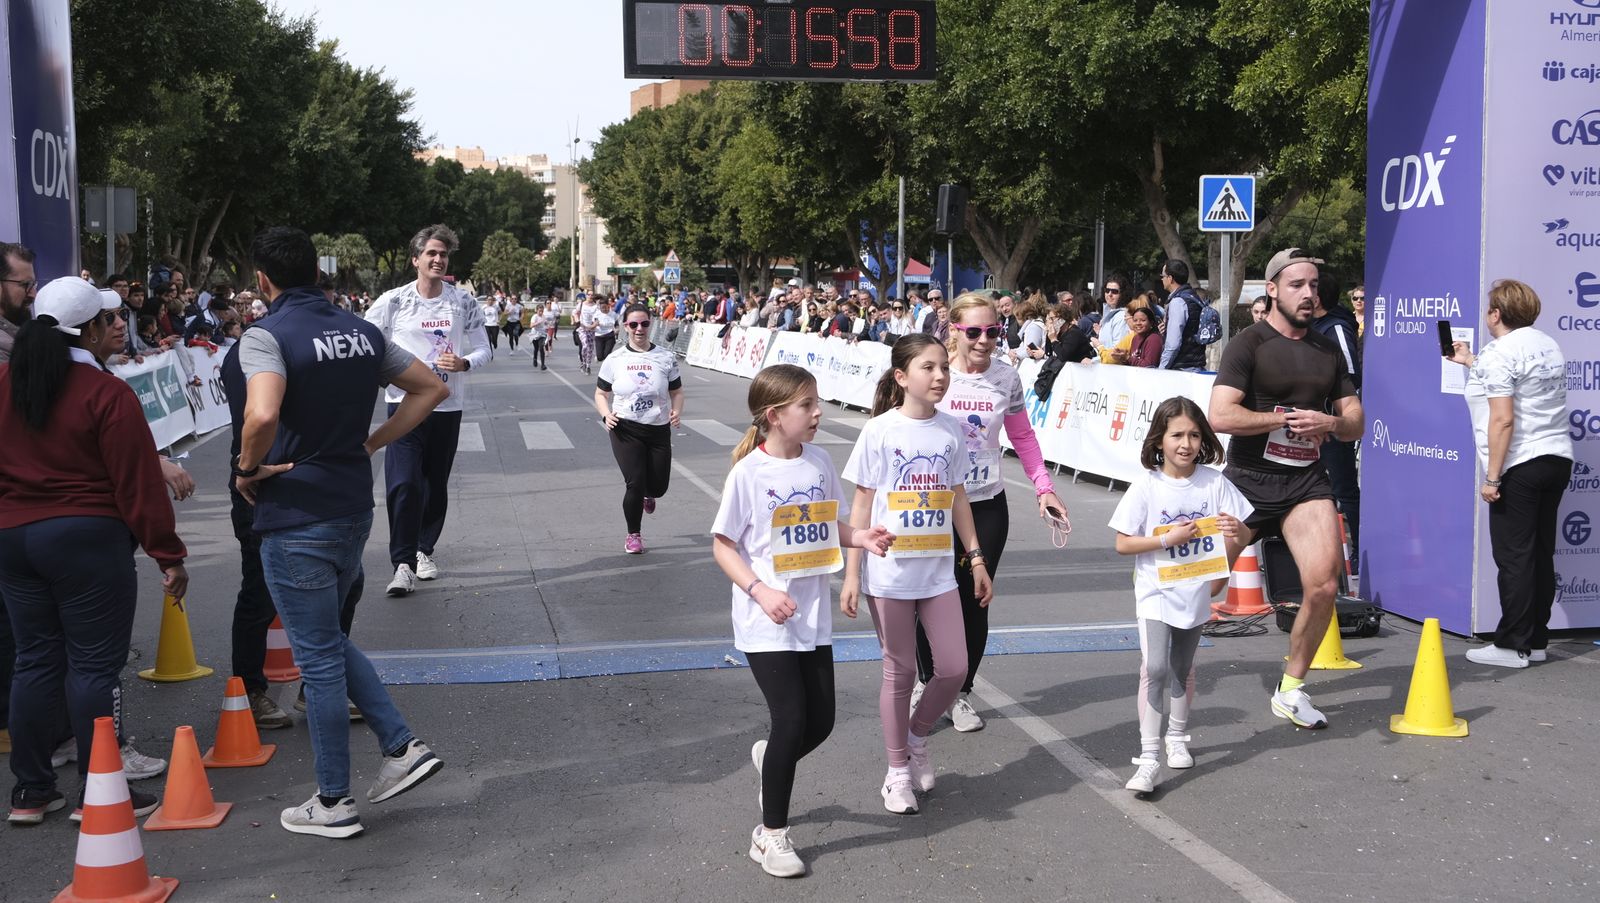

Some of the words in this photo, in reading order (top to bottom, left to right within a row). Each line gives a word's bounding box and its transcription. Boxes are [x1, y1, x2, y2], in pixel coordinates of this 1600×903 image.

[1381, 136, 1457, 212] CDX
[1395, 293, 1462, 318] ALMERÍA
[421, 320, 451, 329] MUJER
[1394, 321, 1426, 334] CIUDAD
[312, 329, 376, 362] NEXA
[950, 400, 994, 412] MUJER
[911, 474, 939, 485] MINI
[965, 466, 989, 480] 11
[899, 509, 945, 528] 1879
[781, 522, 829, 545] 1880
[1165, 536, 1214, 559] 1878
